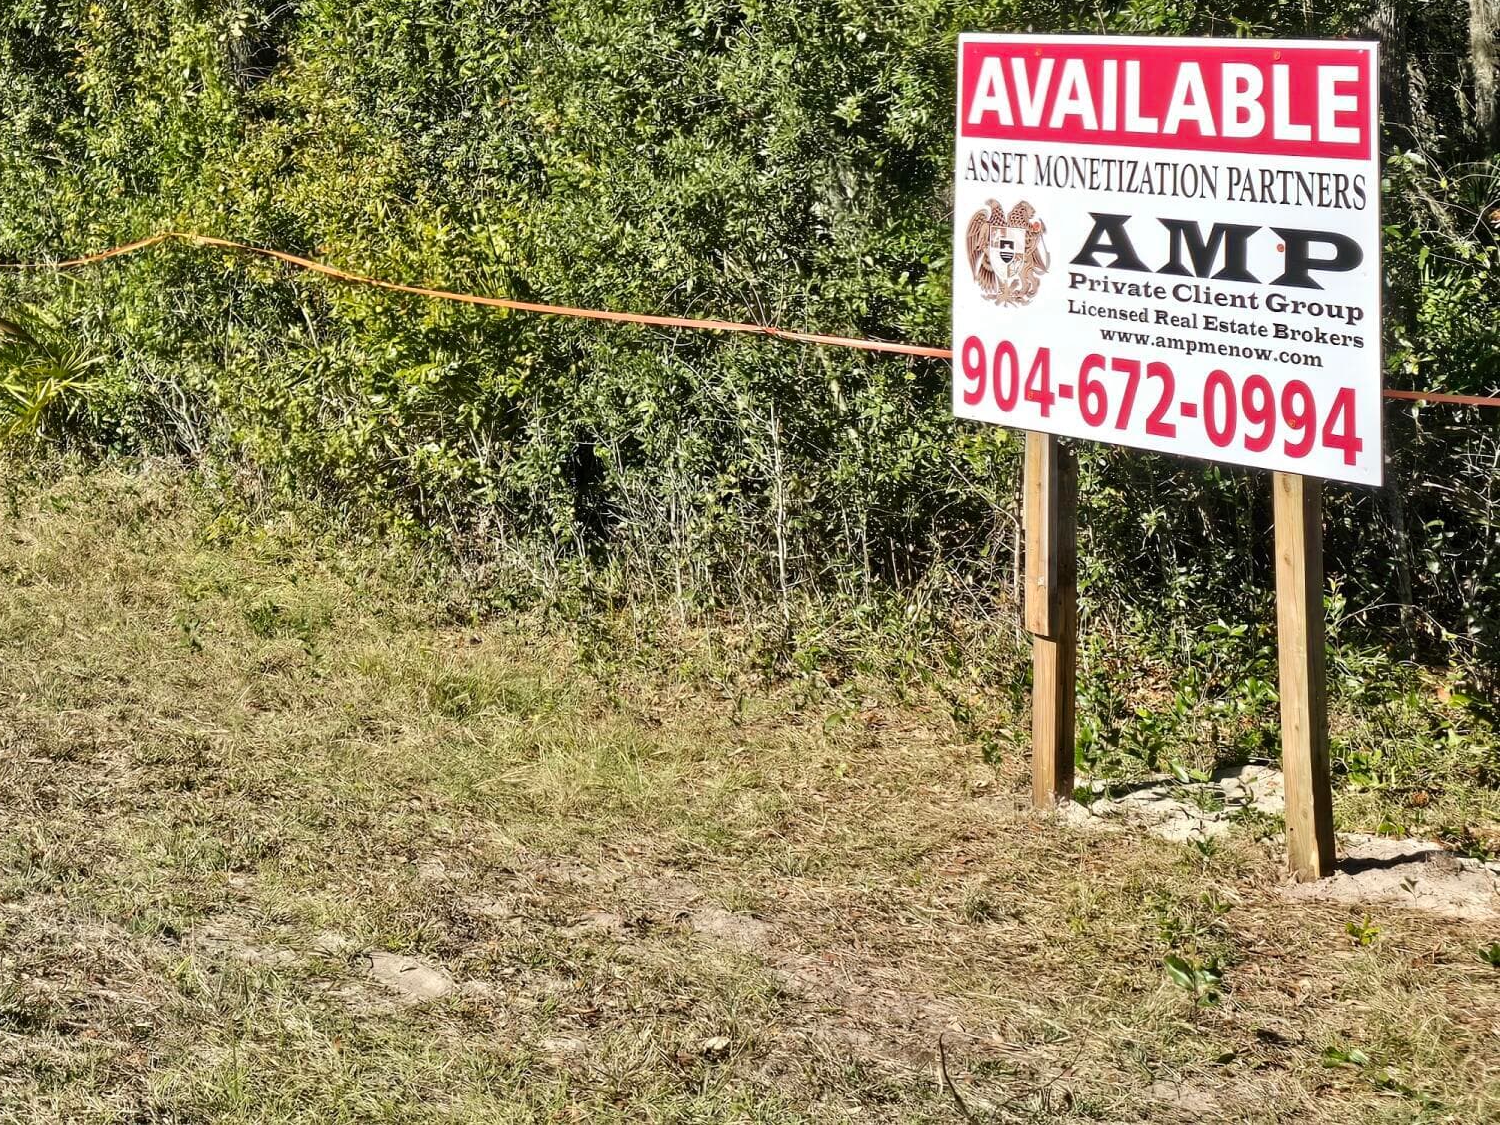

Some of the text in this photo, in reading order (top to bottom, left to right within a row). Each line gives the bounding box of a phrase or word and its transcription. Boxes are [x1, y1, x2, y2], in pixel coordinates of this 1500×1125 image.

[968, 56, 1363, 144] AVAILABLE
[965, 150, 1366, 210] ASSET MONETIZATION PARTNERS
[1069, 212, 1364, 290] AMP
[1068, 299, 1364, 349] Licensed Real Estate Brokers
[1069, 272, 1364, 324] Private Client Group
[1100, 328, 1323, 367] www.ampmenow.com
[961, 335, 1363, 466] 904-672-0994
